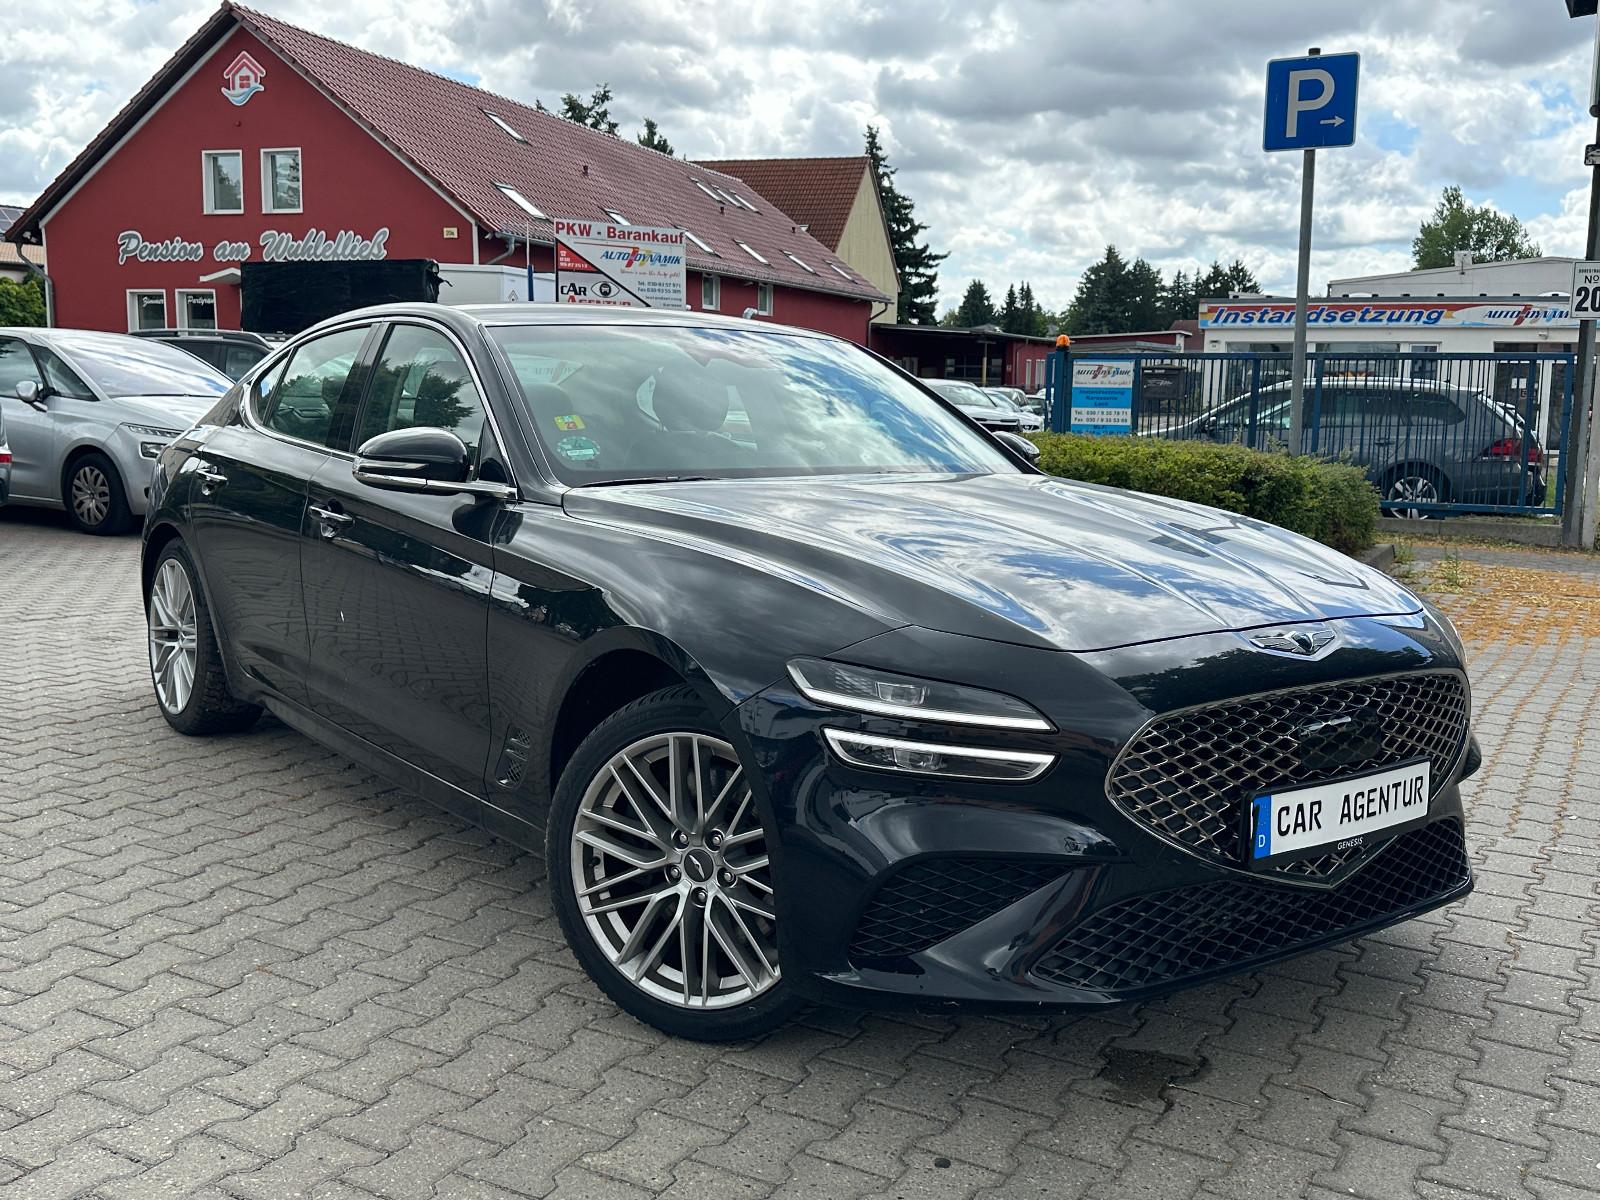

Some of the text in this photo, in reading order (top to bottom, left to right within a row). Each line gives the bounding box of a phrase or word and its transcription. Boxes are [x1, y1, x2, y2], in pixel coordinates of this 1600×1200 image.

[1286, 69, 1335, 138] P
[118, 230, 203, 264] Pension
[214, 239, 251, 262] am
[555, 221, 592, 237] PKW
[607, 226, 685, 245] Barankauf
[1277, 775, 1424, 836] CAR AGENTUR
[1258, 834, 1266, 848] D
[1337, 836, 1364, 850] GENESIS
